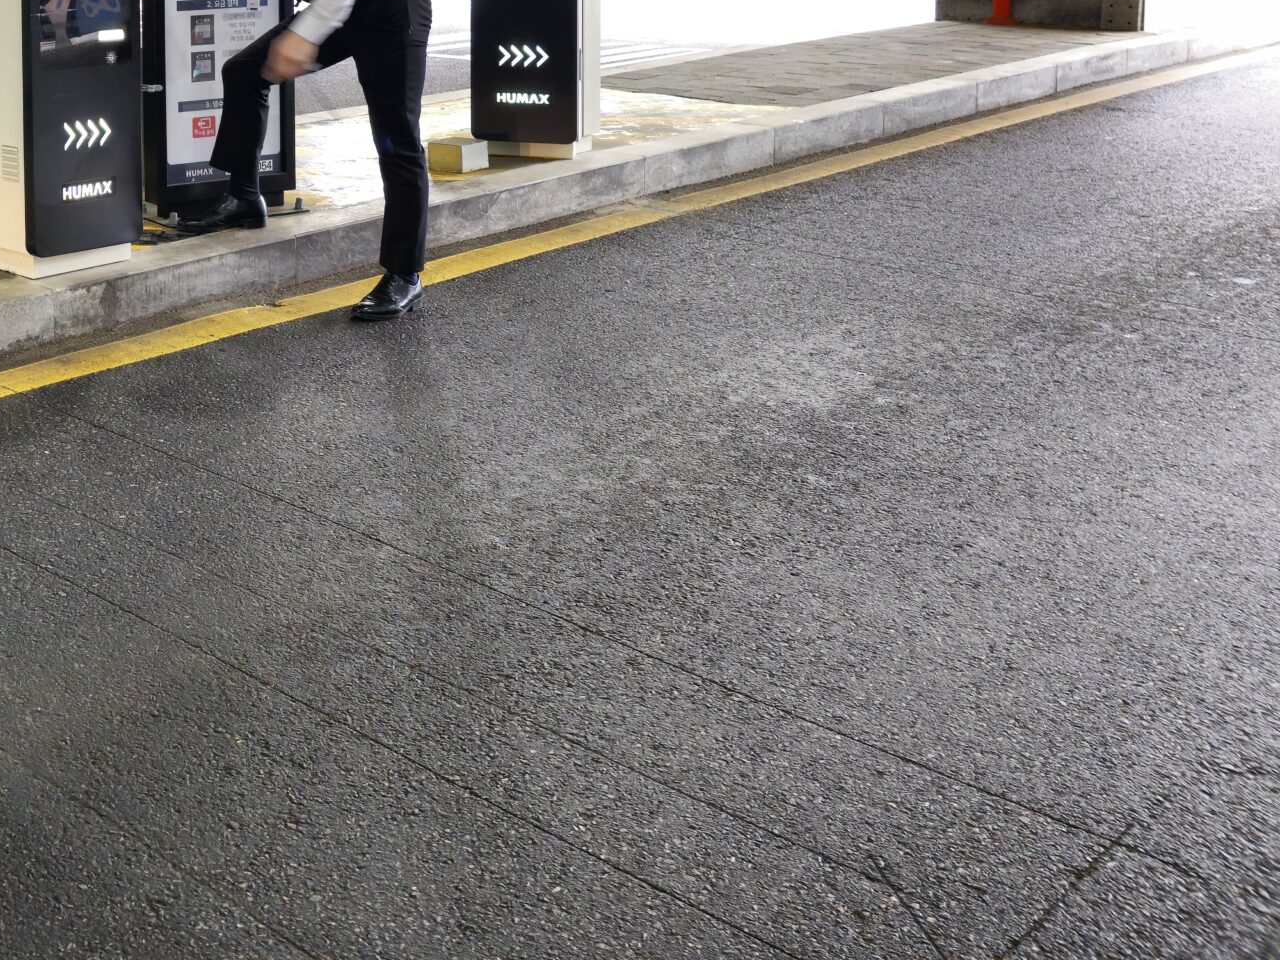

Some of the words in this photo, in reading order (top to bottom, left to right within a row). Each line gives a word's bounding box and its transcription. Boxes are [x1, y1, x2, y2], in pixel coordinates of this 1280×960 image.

[214, 0, 226, 8] 요금
[496, 92, 550, 104] HUMAX
[186, 168, 214, 178] HUMAX
[62, 180, 113, 200] HUMAX
